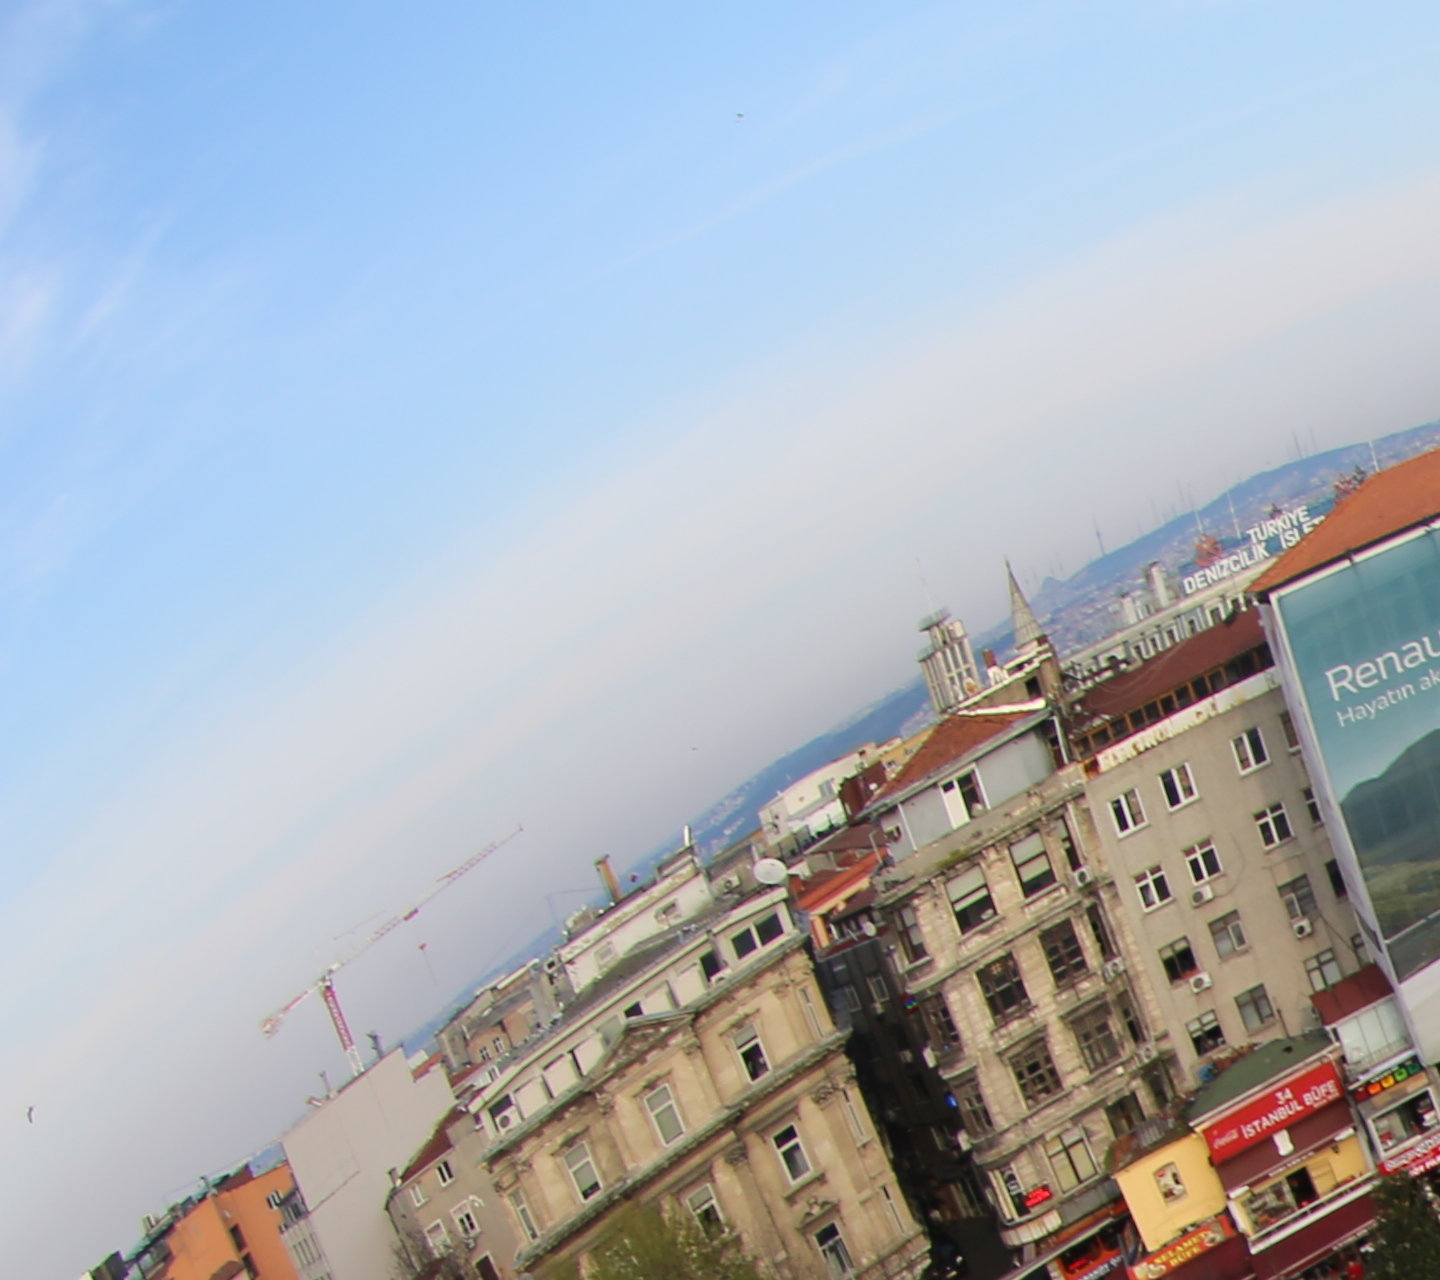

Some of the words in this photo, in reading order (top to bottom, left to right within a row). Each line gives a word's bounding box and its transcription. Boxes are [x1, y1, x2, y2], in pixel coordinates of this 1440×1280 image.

[1247, 505, 1310, 543] TÜRKİYE
[1183, 542, 1270, 594] DENİZCİLİK
[1336, 682, 1415, 727] Hayatın
[1241, 1100, 1304, 1140] İSTANBUL
[1303, 1079, 1338, 1107] BÜFE
[1275, 1087, 1294, 1105] 34
